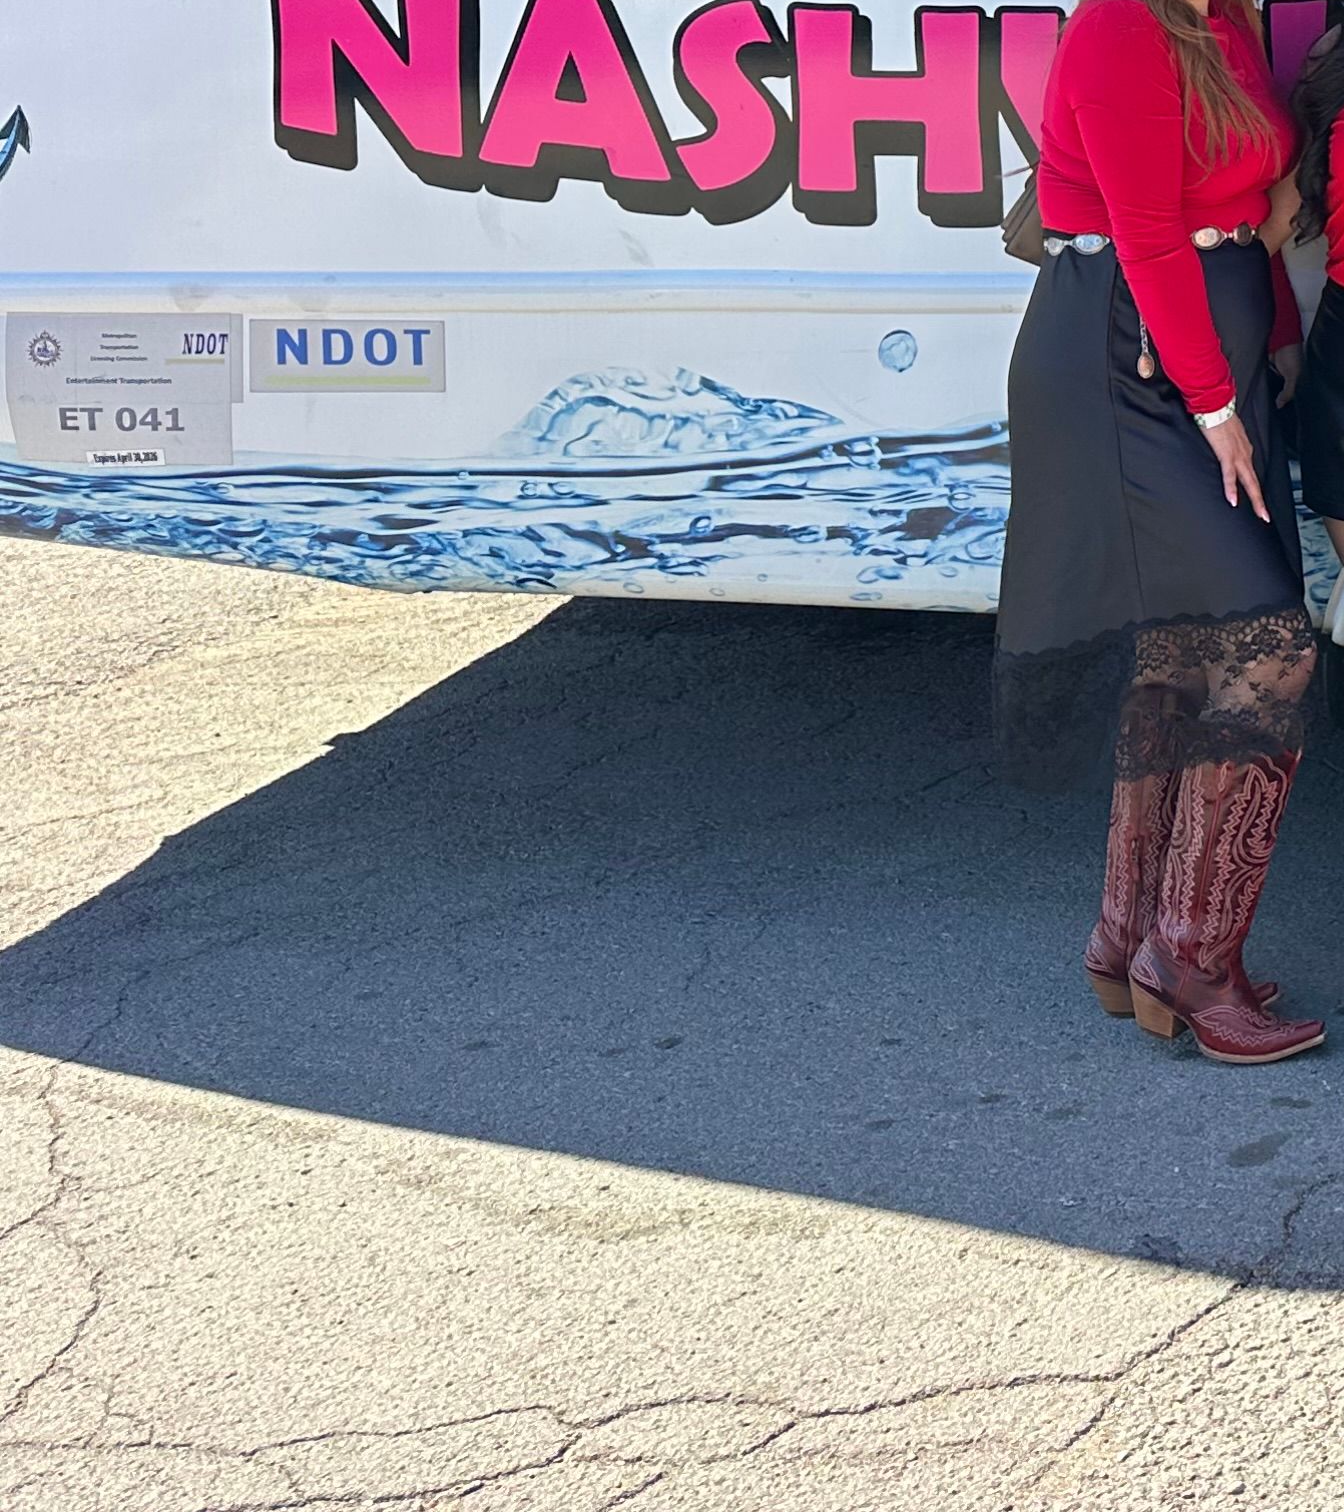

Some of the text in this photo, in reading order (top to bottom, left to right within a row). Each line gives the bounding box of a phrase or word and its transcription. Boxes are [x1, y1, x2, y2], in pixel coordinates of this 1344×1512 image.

[182, 333, 229, 355] NDOT
[275, 328, 431, 366] NDOT
[58, 407, 185, 432] ET 041
